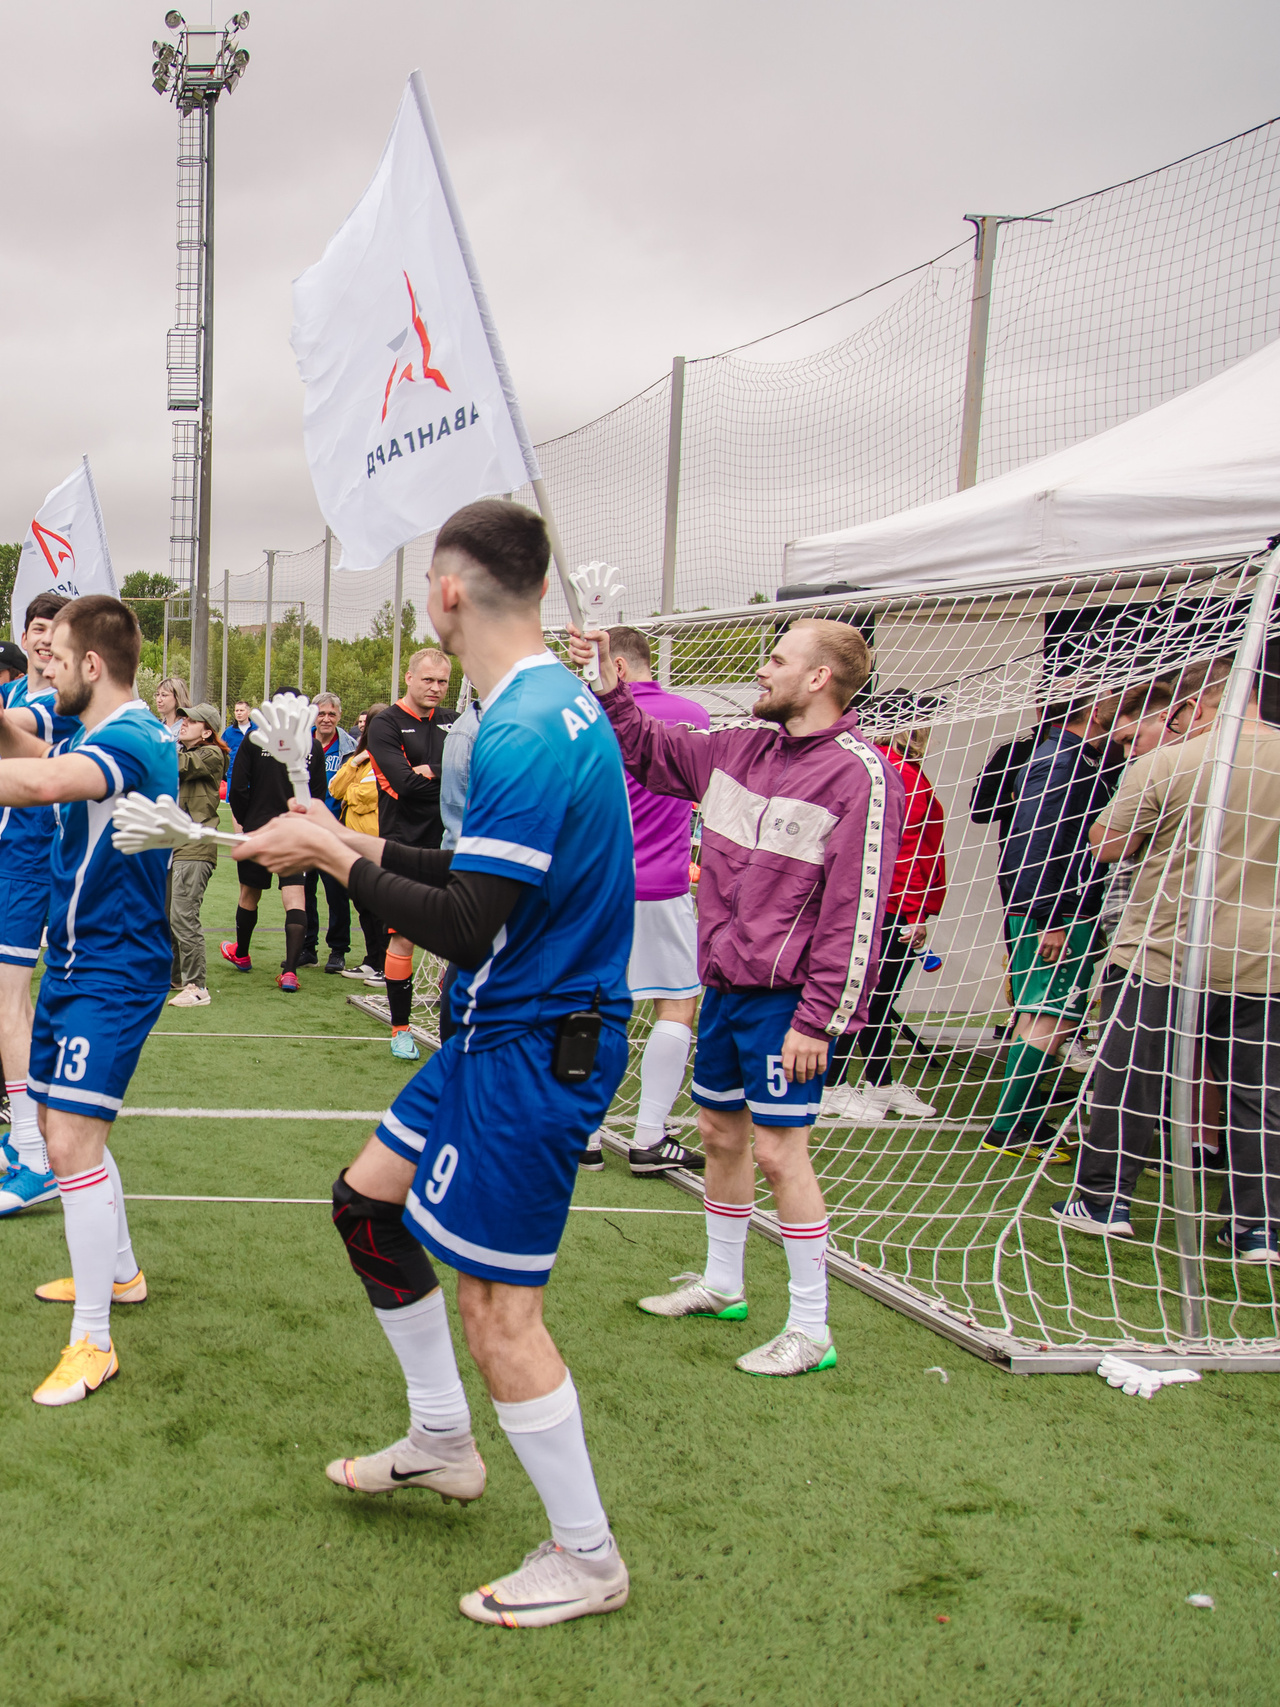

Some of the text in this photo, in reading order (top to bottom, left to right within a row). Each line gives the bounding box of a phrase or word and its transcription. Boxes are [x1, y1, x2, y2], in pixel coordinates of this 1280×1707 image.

[1064, 985, 1081, 1009] 2
[54, 1036, 90, 1082] 13
[766, 1054, 788, 1098] 5
[425, 1143, 459, 1205] 9
